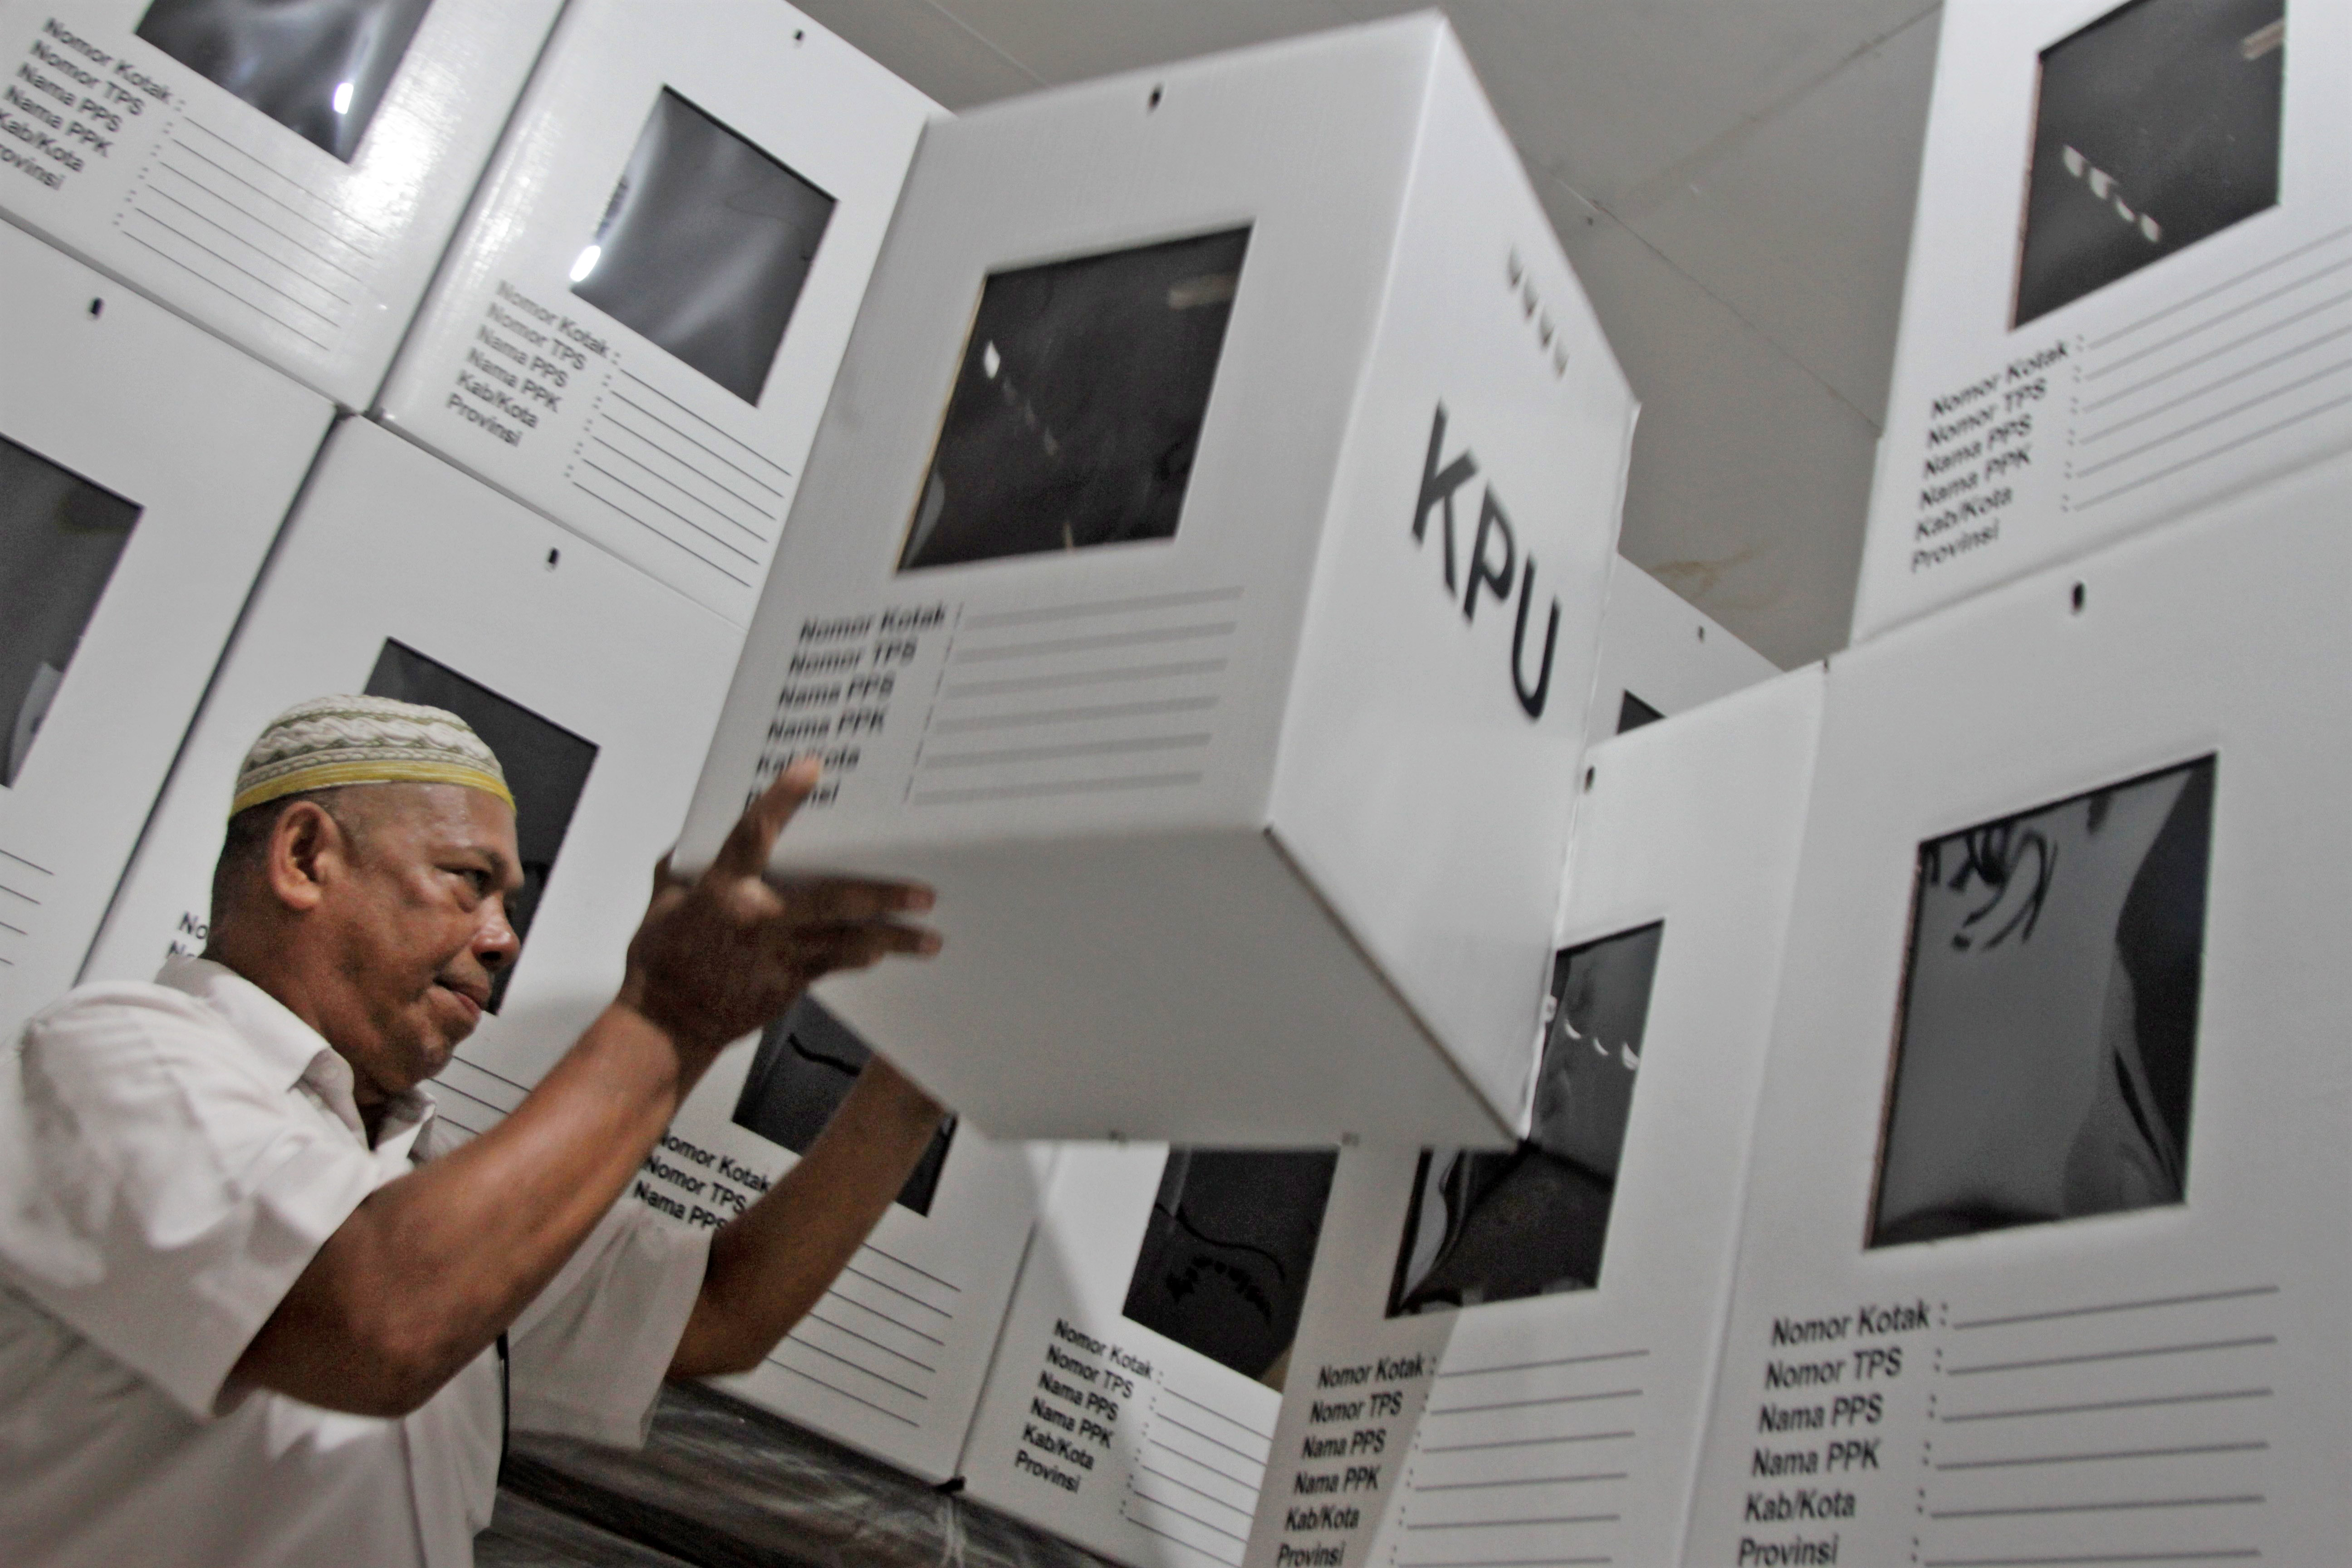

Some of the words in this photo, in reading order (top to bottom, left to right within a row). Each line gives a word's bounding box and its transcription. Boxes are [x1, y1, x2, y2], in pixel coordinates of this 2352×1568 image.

[29, 40, 100, 89] Nomor
[104, 80, 145, 116] TPS
[43, 18, 113, 66] Nomor
[114, 59, 172, 104] Kotak
[2, 85, 63, 129] Nama
[65, 121, 113, 157] PPK
[16, 62, 76, 107] Nama
[78, 97, 122, 132] PPS
[486, 302, 547, 348] Nomor
[551, 338, 587, 370] TPS
[497, 279, 558, 325] Nomor
[558, 317, 610, 358] Kotak
[466, 347, 518, 387] Nama
[521, 378, 562, 413] PPK
[476, 323, 527, 365] Nama
[530, 356, 568, 387] PPS
[446, 392, 523, 446] Provinsi
[456, 370, 539, 428] Kab/Kota
[1411, 396, 1561, 722] KPU
[645, 1155, 706, 1195] Nomor
[710, 1181, 746, 1215] TPS
[719, 1155, 771, 1191] Kotak
[633, 1179, 686, 1219] Nama
[1772, 1316, 1852, 1347] Nomor
[1857, 1298, 1930, 1336] Kotak
[1047, 1343, 1100, 1384] Nomor
[1103, 1369, 1134, 1399] TPS
[1054, 1317, 1107, 1356] Nomor
[1109, 1345, 1153, 1381] Kotak
[1317, 1364, 1373, 1390] Nomor
[1376, 1351, 1424, 1382] Kotak
[1764, 1360, 1846, 1391] Nomor
[1853, 1346, 1903, 1380] TPS
[1038, 1369, 1083, 1406] Nama
[1086, 1392, 1118, 1421] PPS
[1309, 1400, 1366, 1424] Nomor
[1370, 1389, 1403, 1417] TPS
[1759, 1402, 1825, 1434] Nama
[1831, 1392, 1884, 1427] PPS
[1022, 1422, 1094, 1470] Kab/Kota
[1030, 1395, 1075, 1431] Nama
[1079, 1418, 1113, 1449] PPK
[1302, 1436, 1347, 1460] Nama
[1350, 1428, 1387, 1454] PPS
[1015, 1449, 1081, 1493] Provinsi
[1294, 1471, 1339, 1494] Nama
[1343, 1464, 1381, 1491] PPK
[1752, 1447, 1818, 1478] Nama
[1827, 1437, 1882, 1472] PPK
[1284, 1503, 1360, 1531] Kab/Kota
[1745, 1488, 1856, 1523] Kab/Kota
[1277, 1539, 1347, 1568] Provinsi
[1737, 1531, 1839, 1567] Provinsi
